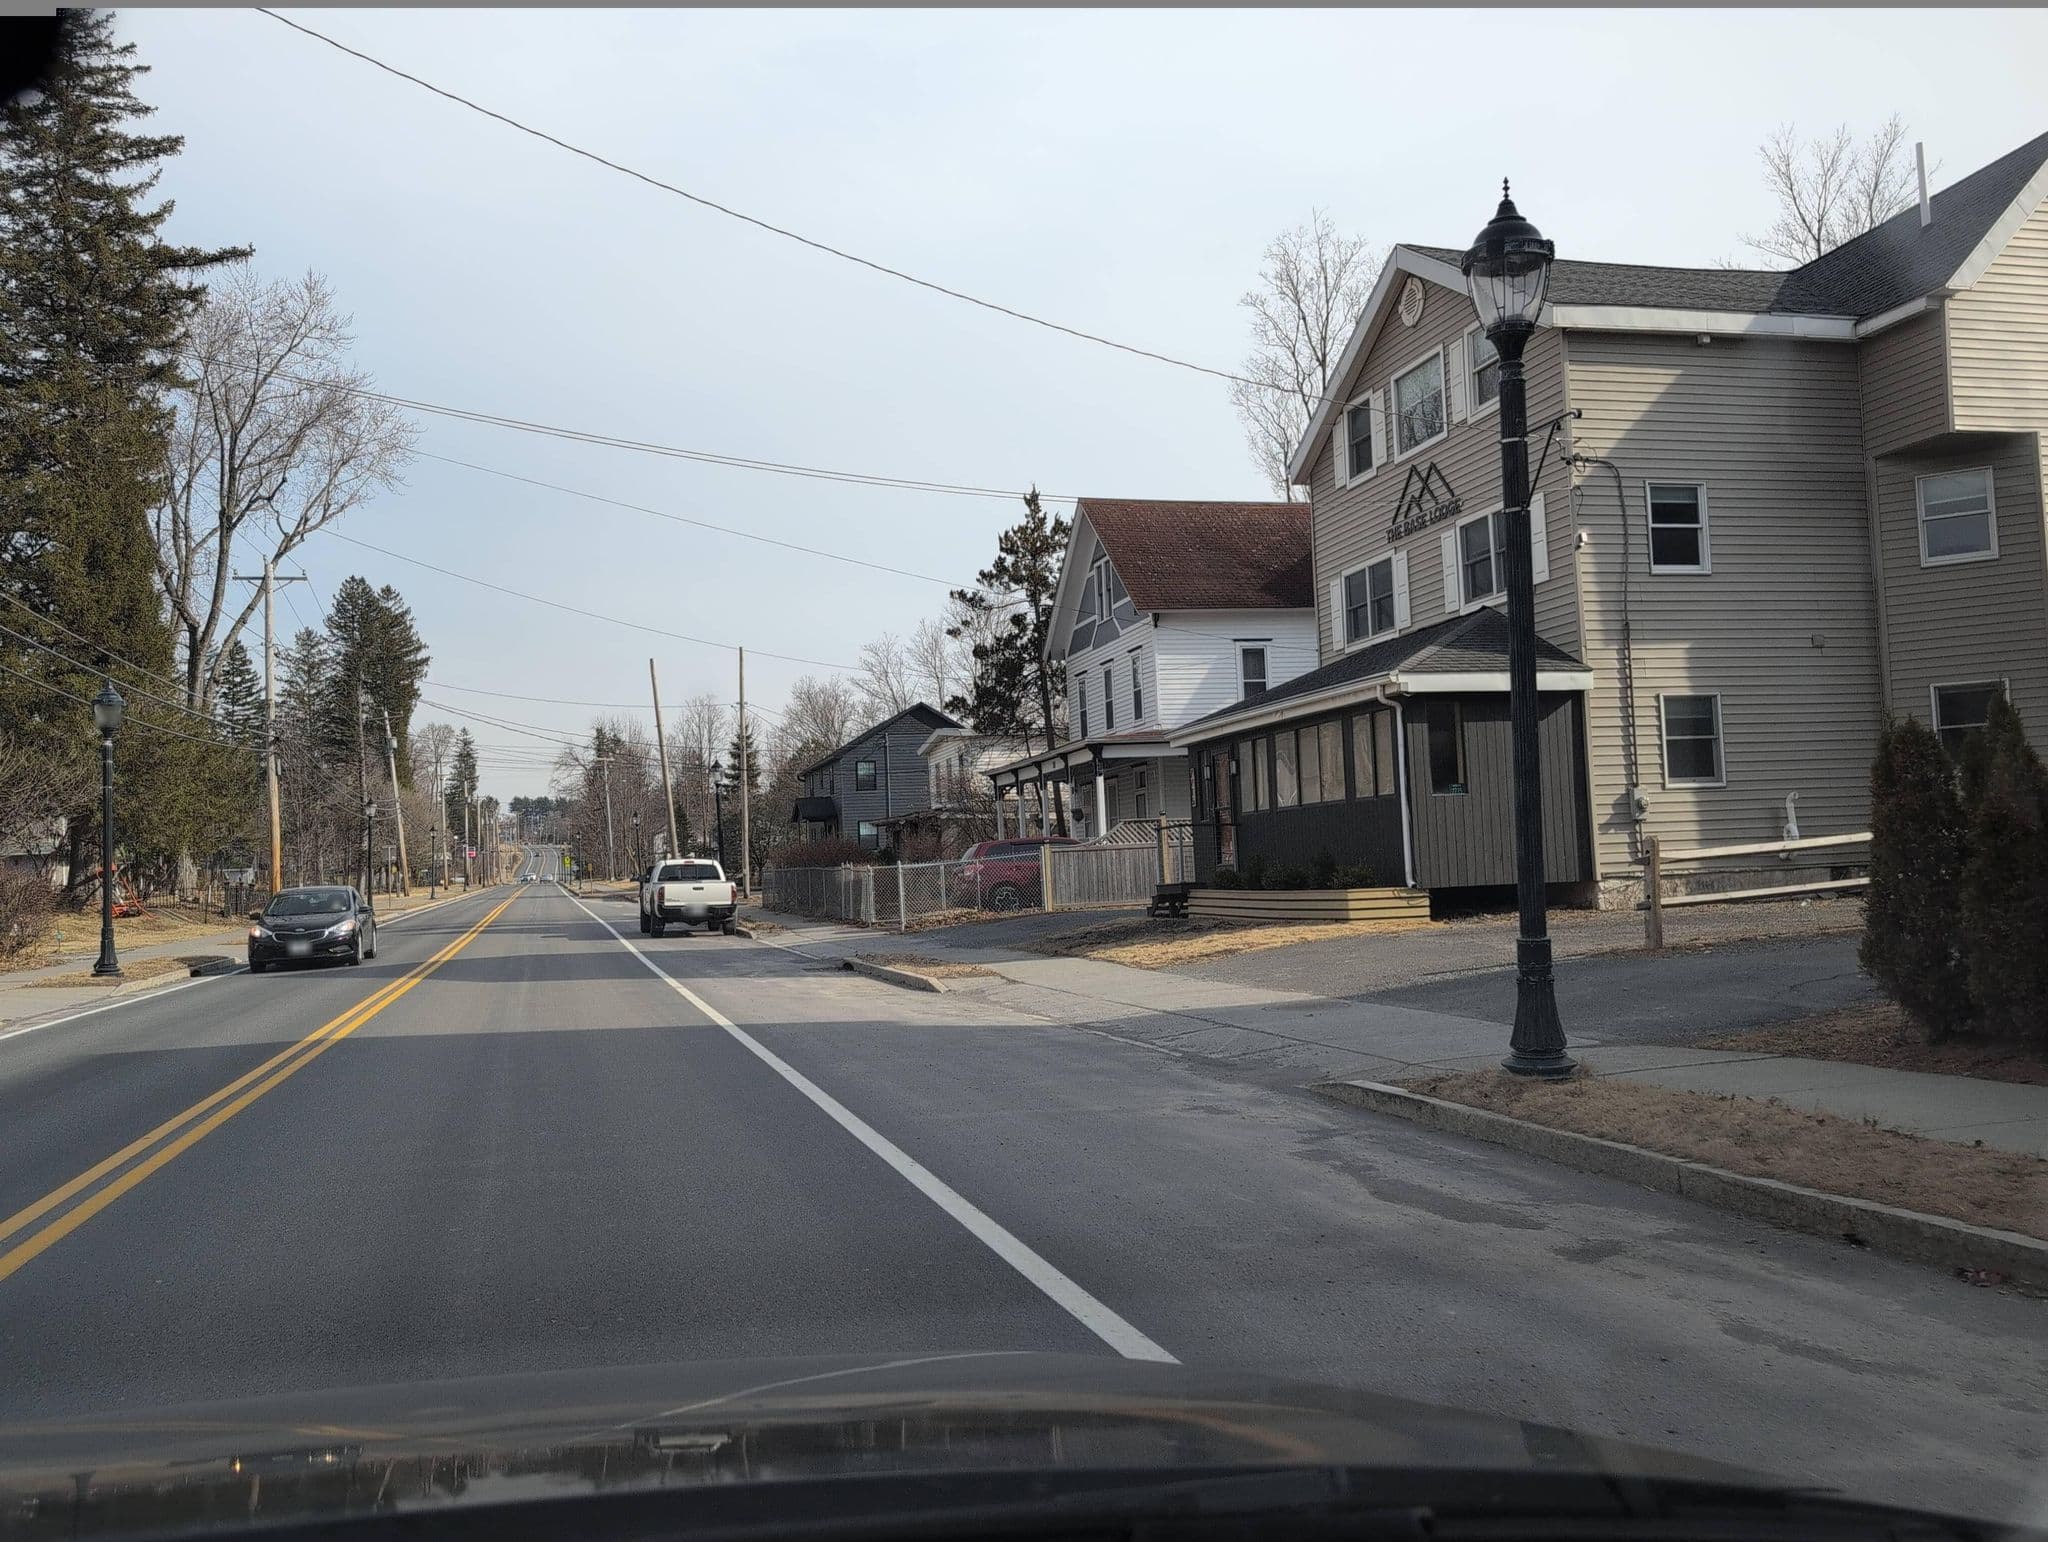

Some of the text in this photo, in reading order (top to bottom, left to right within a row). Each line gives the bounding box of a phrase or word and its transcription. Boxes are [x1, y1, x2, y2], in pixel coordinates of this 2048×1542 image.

[1386, 498, 1462, 543] THE BASE LODGE
